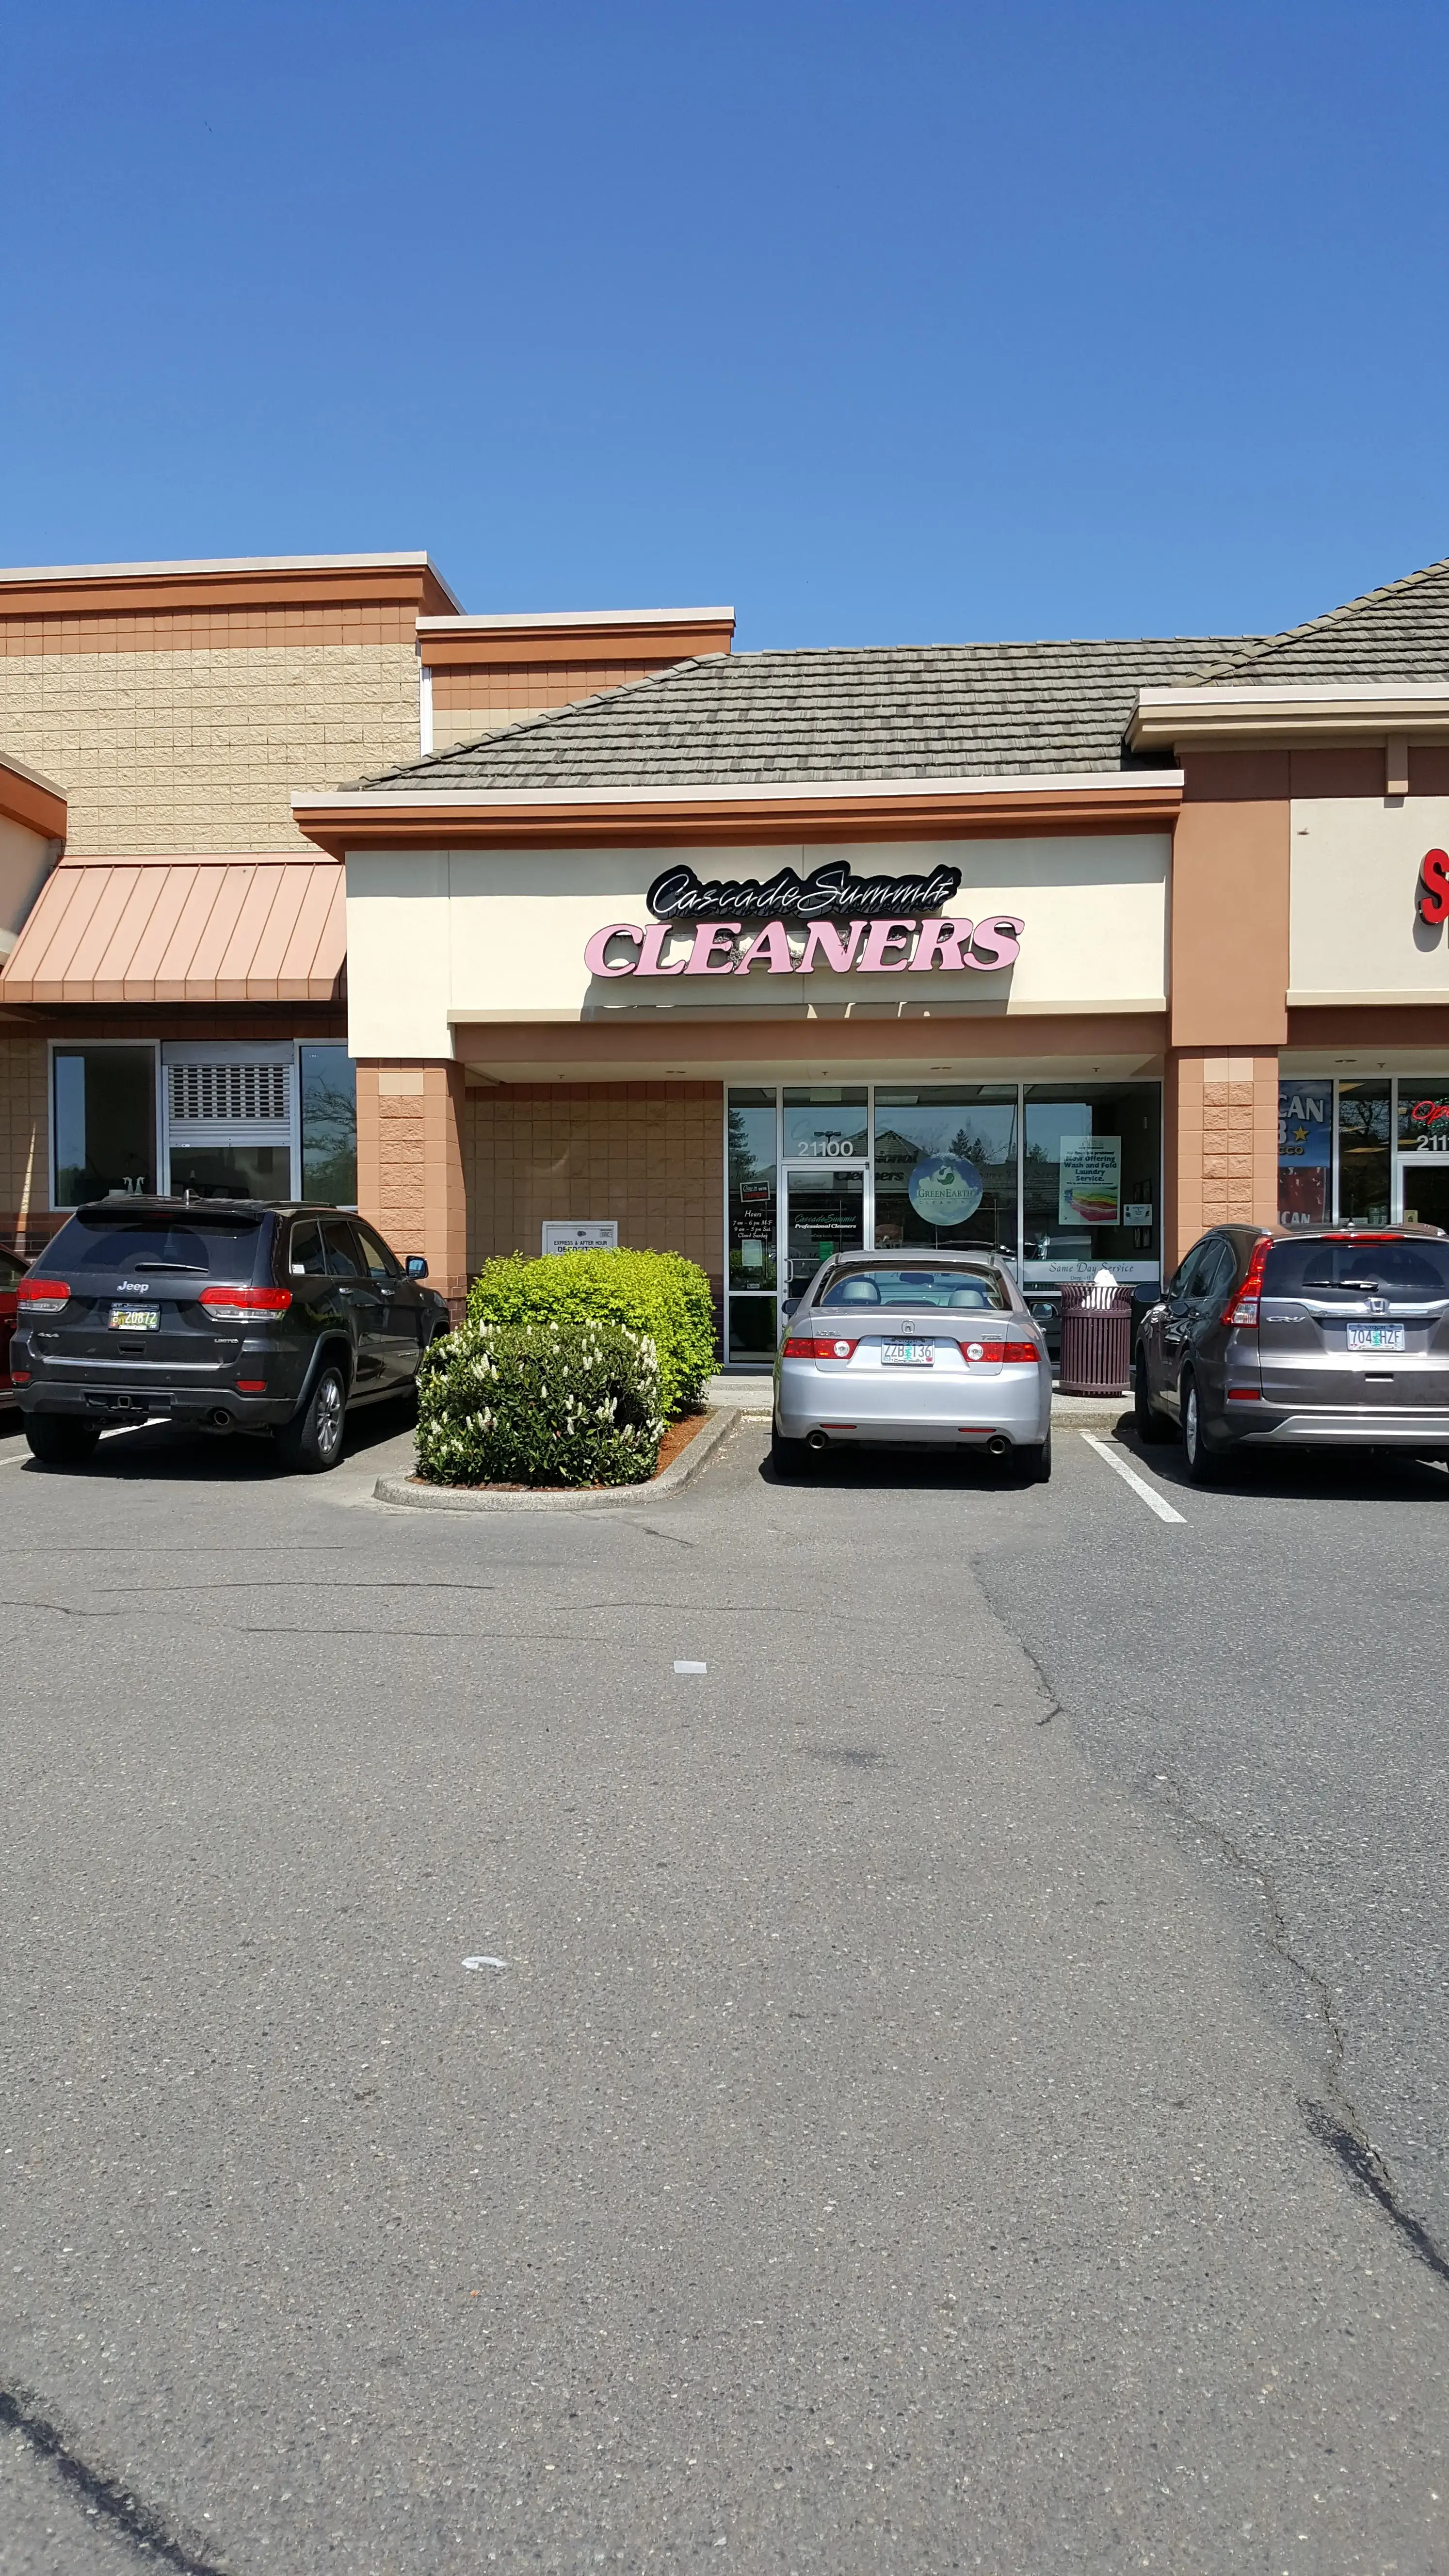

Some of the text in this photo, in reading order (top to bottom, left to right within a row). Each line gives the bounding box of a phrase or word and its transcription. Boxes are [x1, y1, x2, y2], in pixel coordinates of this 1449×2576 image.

[652, 870, 955, 914] Cascade Summit
[584, 916, 1026, 977] CLEANERS
[798, 1141, 853, 1157] 21100
[795, 1214, 856, 1223] Cascade Summit
[1049, 1262, 1134, 1274] Same Day Service
[117, 1281, 149, 1294] Jeep
[125, 1312, 156, 1324] 20872
[1351, 1330, 1401, 1344] 704 HZF
[885, 1343, 931, 1357] ZZB 136
